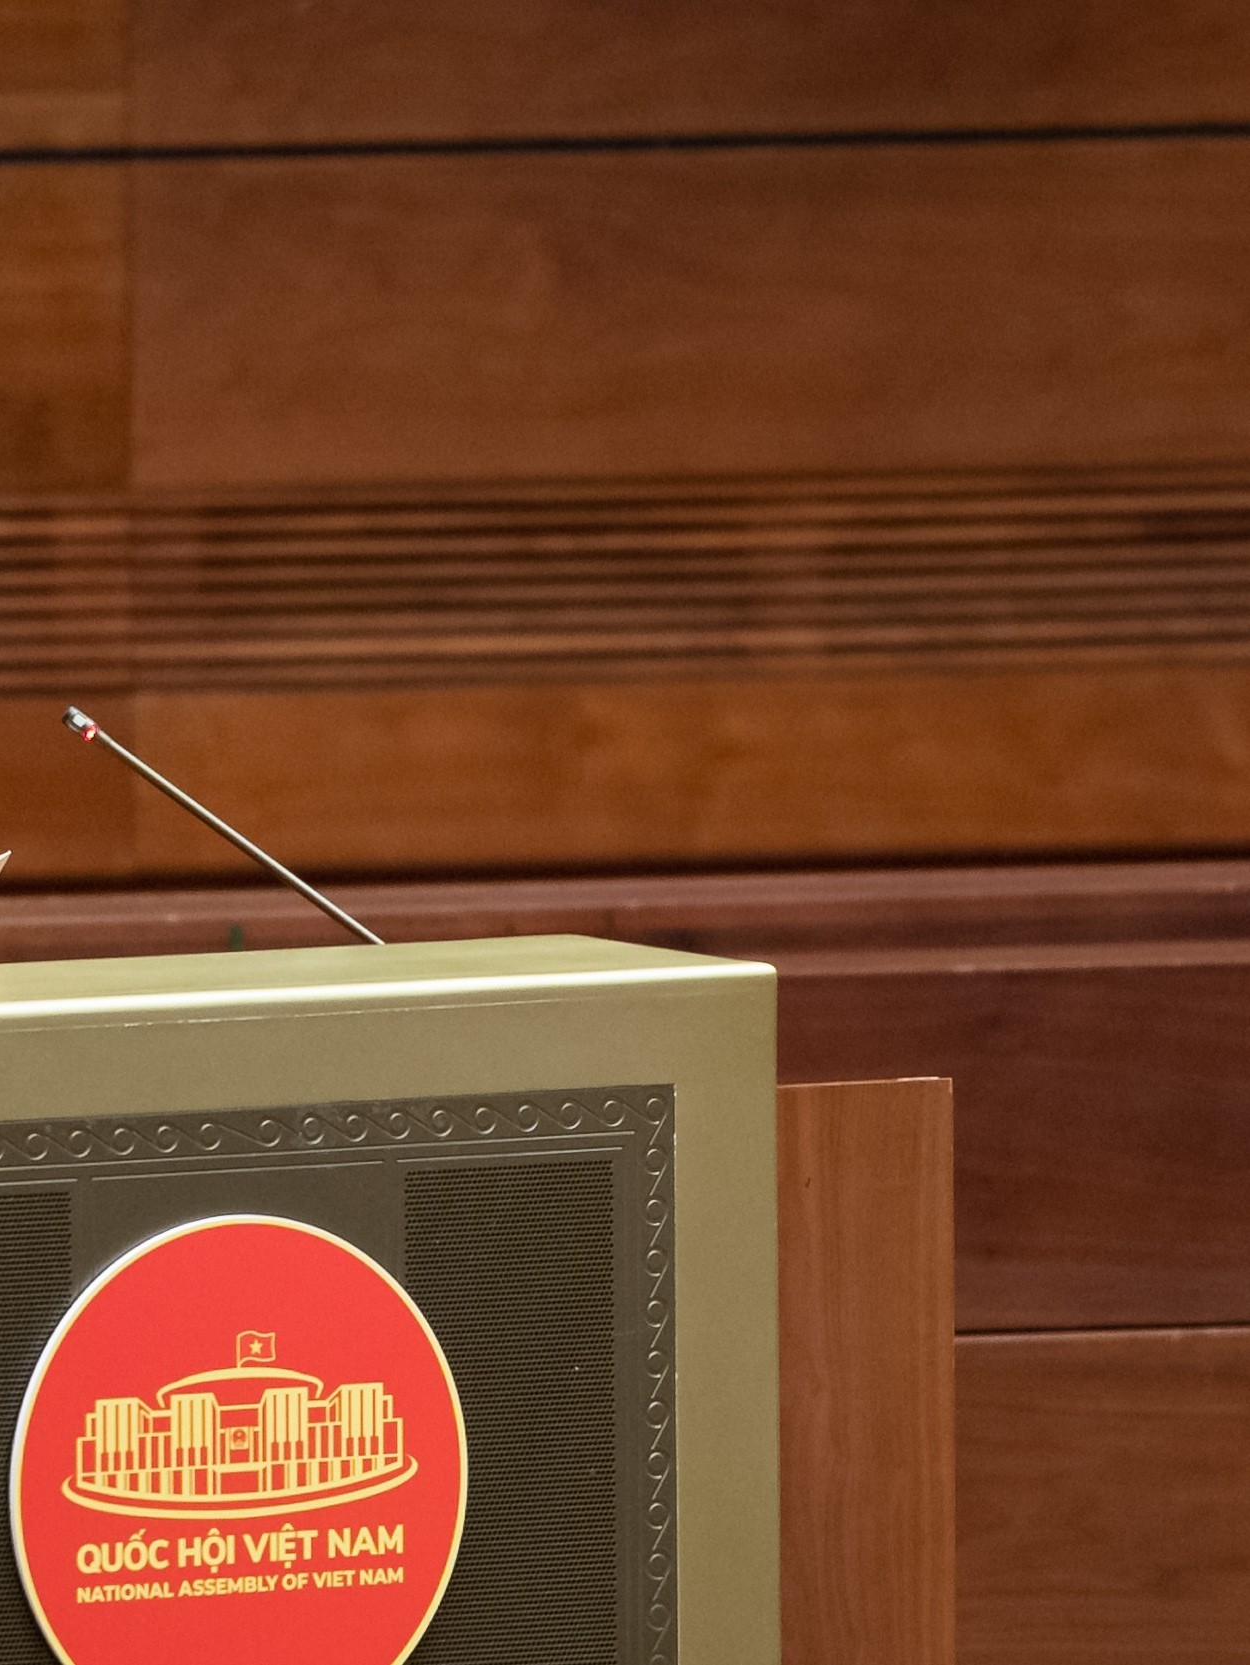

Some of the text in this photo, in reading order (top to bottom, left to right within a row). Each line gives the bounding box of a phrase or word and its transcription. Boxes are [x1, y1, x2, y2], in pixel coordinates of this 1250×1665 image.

[76, 1522, 405, 1575] QUỐC HỘI VIỆT NAM
[76, 1567, 405, 1604] NATIONAL ASSEMBLY OF VIET NAM
